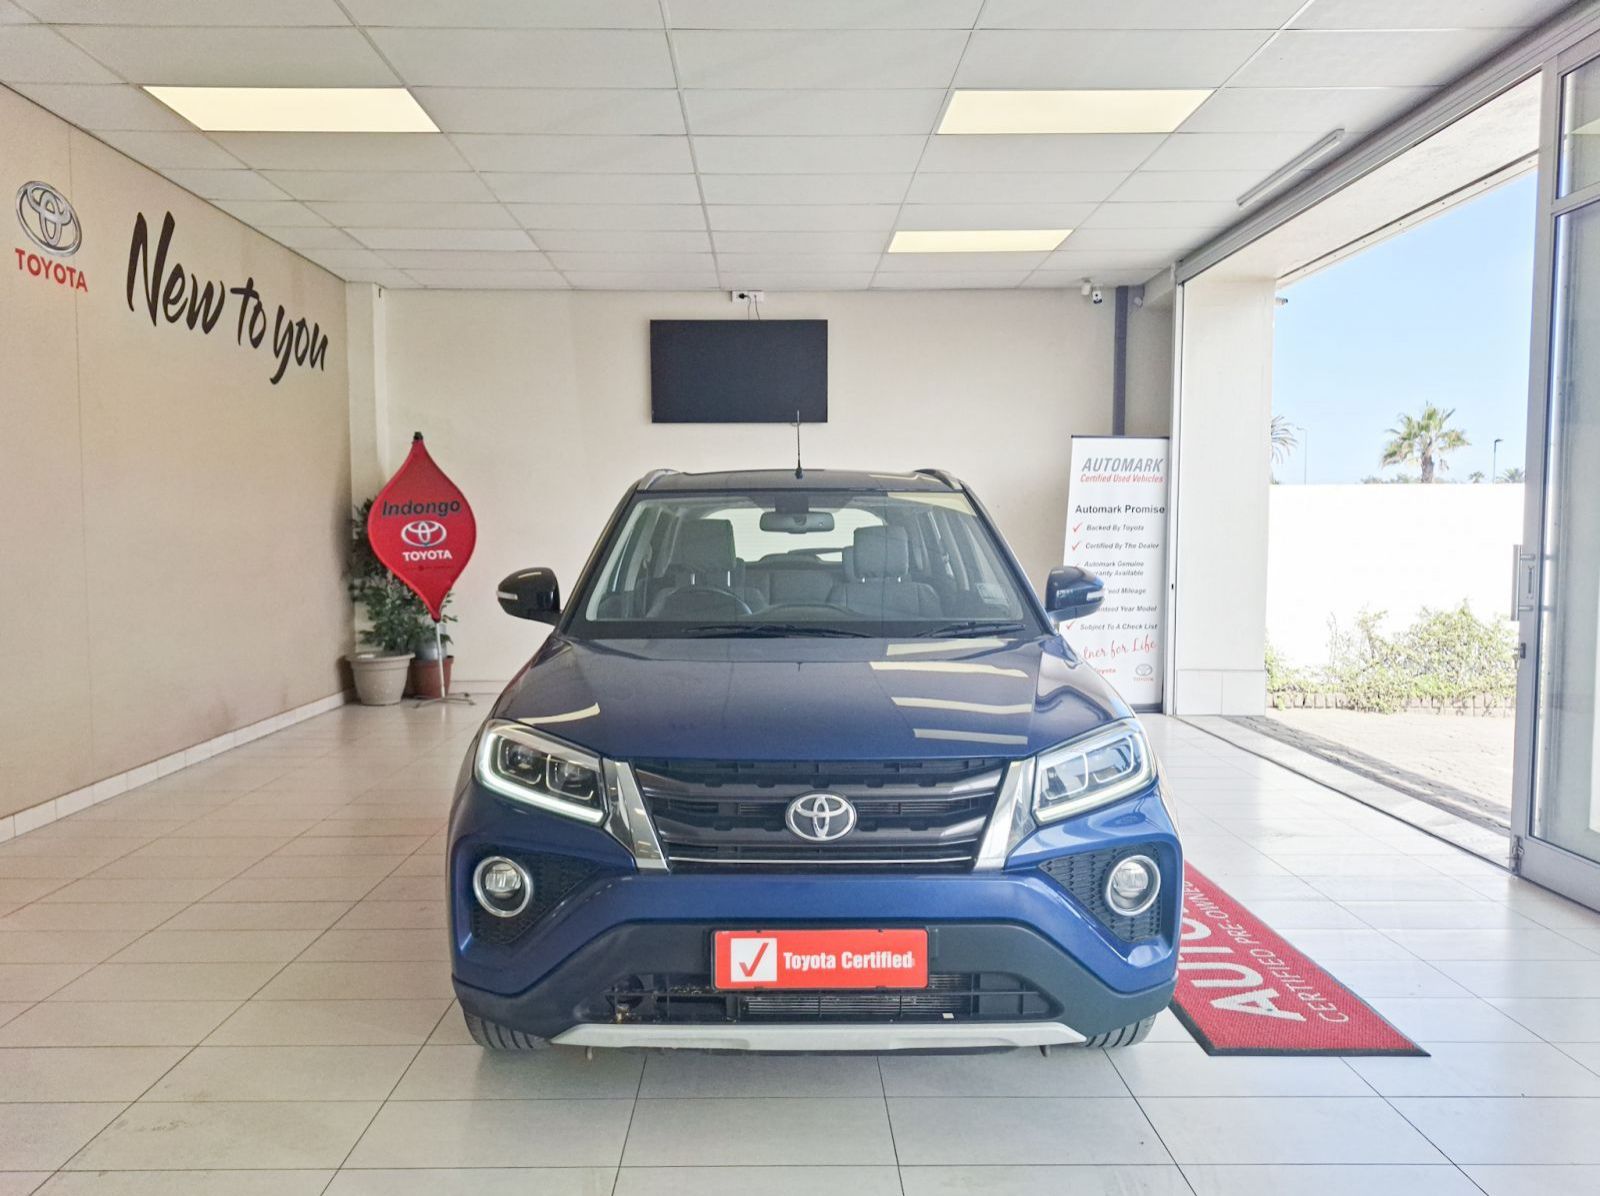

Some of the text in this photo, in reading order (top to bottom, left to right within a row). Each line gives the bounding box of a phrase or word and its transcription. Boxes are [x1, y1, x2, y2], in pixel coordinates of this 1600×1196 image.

[15, 248, 88, 292] TOYOTA
[126, 211, 329, 385] New to you
[1082, 458, 1163, 472] AUTOMARK
[1080, 473, 1164, 483] Certified Used Vehicles
[382, 500, 462, 517] Indongo
[1075, 505, 1165, 514] Automark Promise
[1122, 524, 1144, 532] Toyota
[402, 550, 453, 561] TOYOTA
[783, 951, 913, 971] Toyota Certified
[1250, 948, 1349, 1023] CERTIFIED
